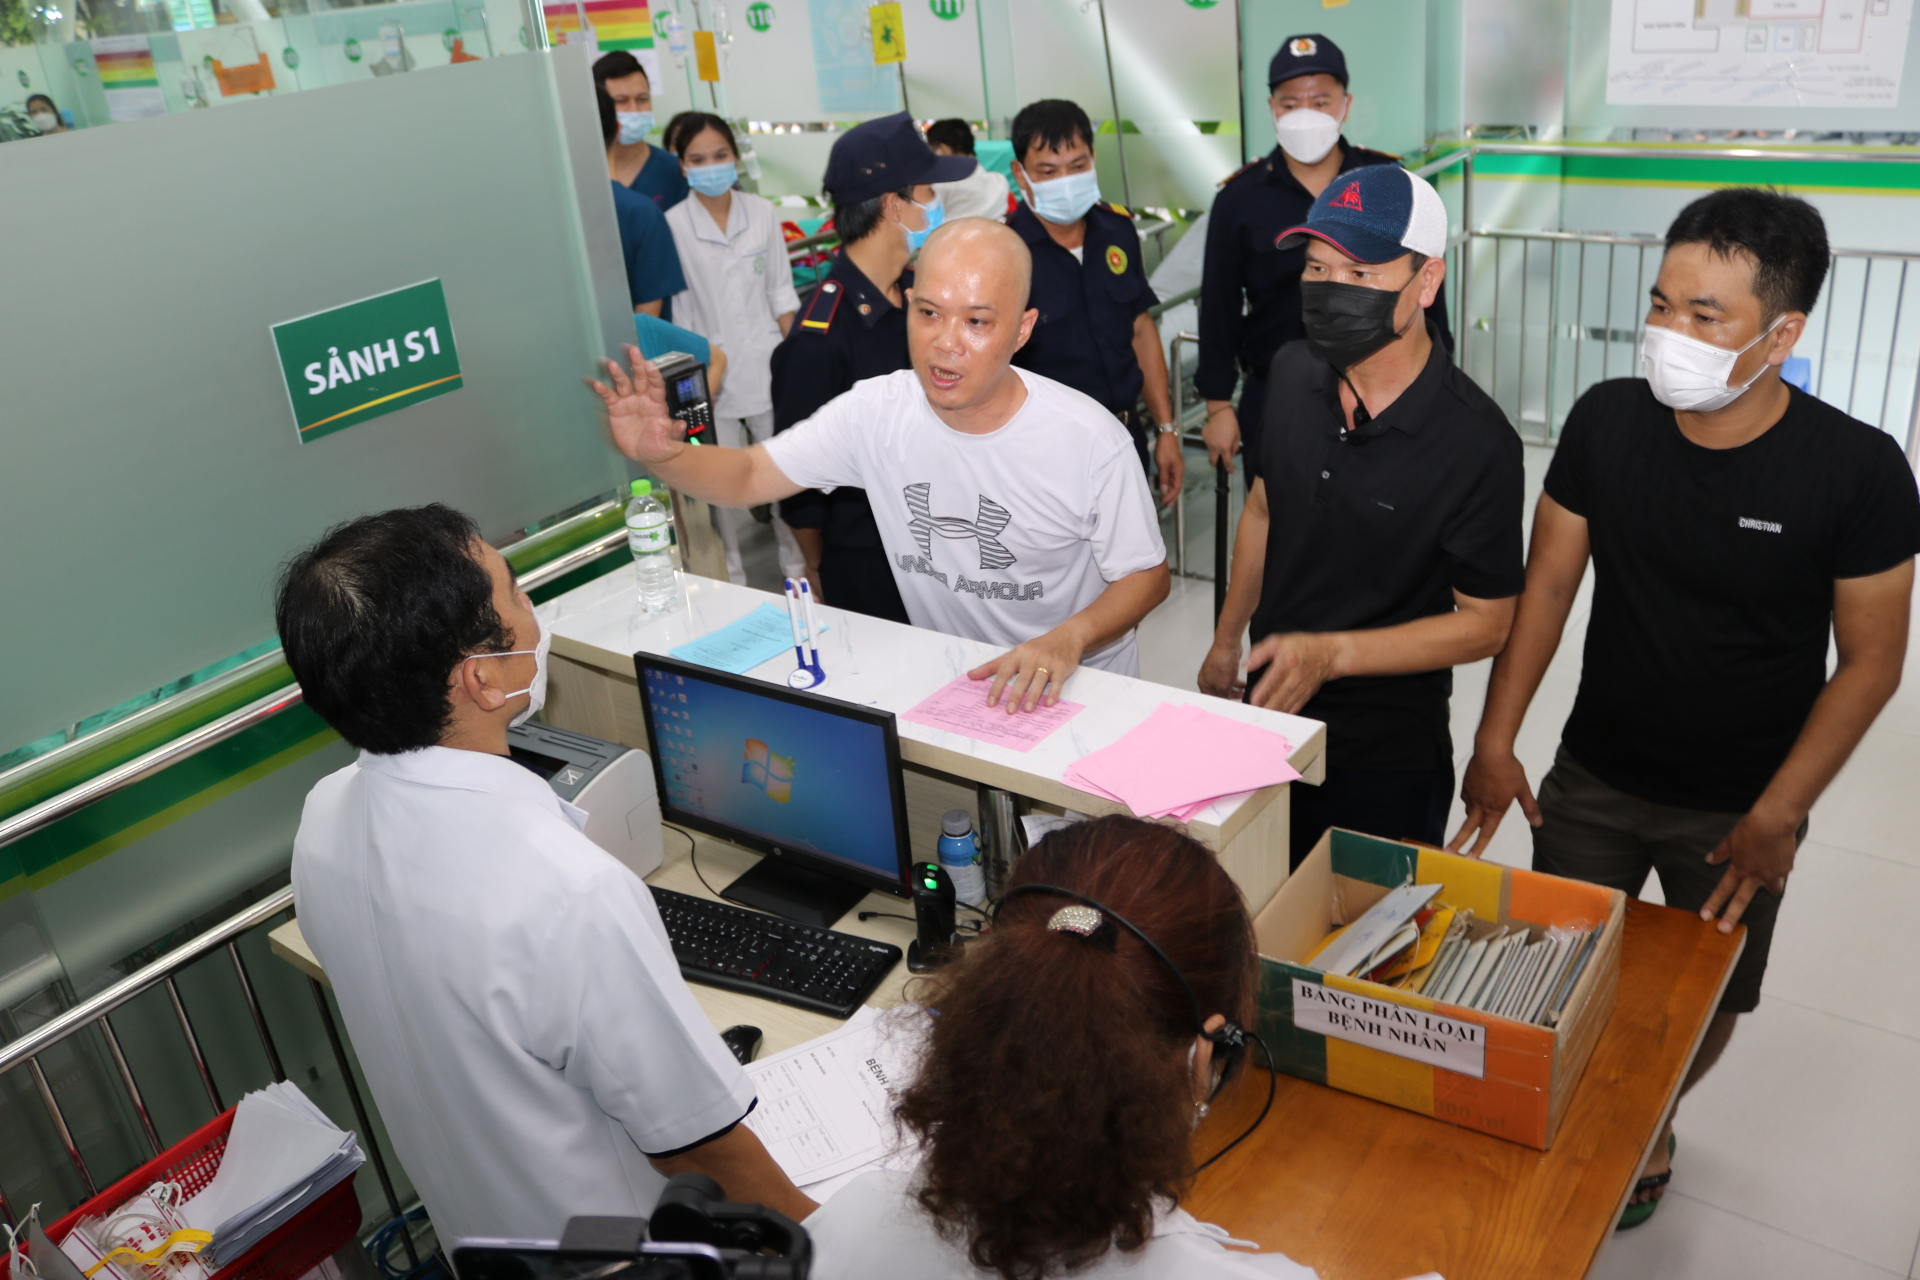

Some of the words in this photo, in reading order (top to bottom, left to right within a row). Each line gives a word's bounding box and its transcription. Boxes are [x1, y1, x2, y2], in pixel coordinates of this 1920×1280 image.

[304, 338, 400, 395] SẢNH
[403, 326, 441, 363] S1
[1738, 516, 1782, 534] CHRISTIAN
[954, 575, 1044, 601] ARMOUR
[1300, 984, 1356, 1011] BẢNG
[1362, 1000, 1418, 1027] PHÂN
[1425, 1016, 1477, 1043] LOẠI
[1328, 1010, 1383, 1037] BỆNH
[1388, 1026, 1447, 1053] NHÂN
[865, 1058, 890, 1085] BỆNH
